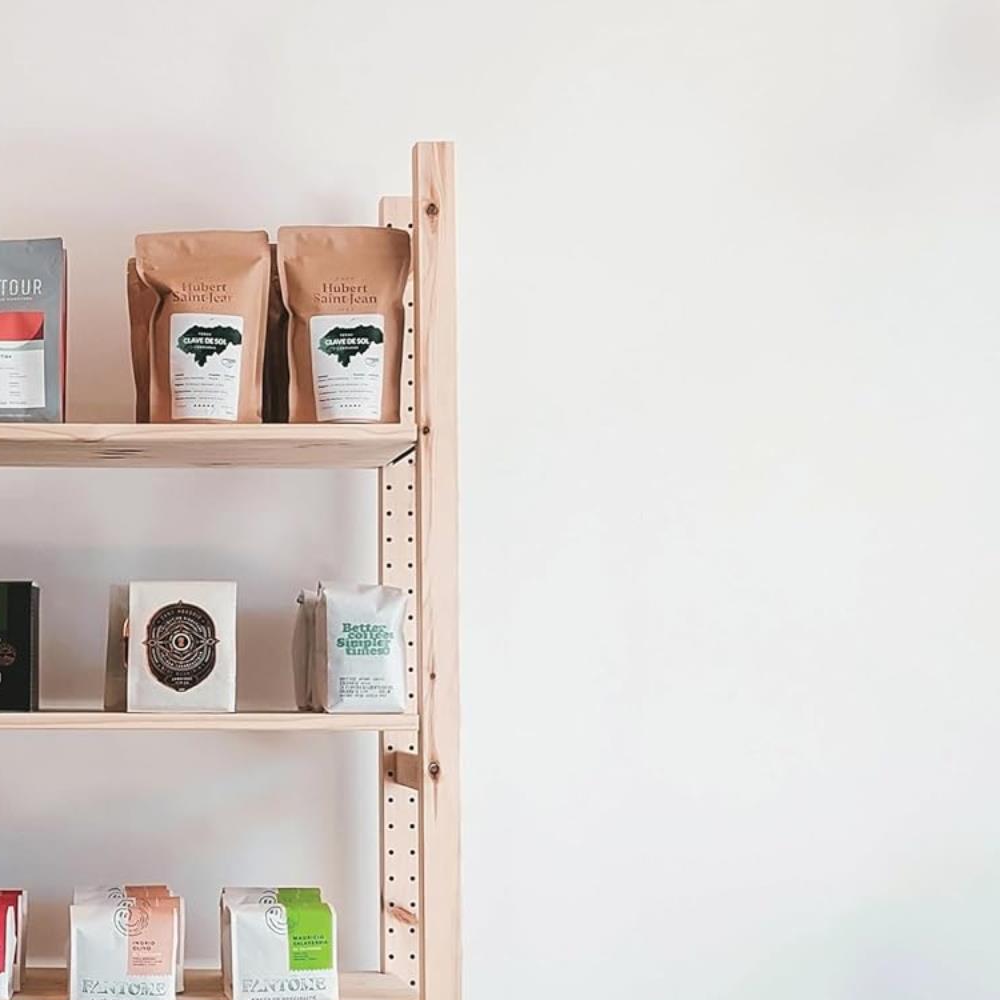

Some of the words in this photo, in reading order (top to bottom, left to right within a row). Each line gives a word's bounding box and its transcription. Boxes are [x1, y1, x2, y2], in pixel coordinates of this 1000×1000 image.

[181, 281, 228, 293] Hubert
[322, 282, 368, 294] Hubert
[183, 336, 204, 345] CLAVE
[204, 337, 214, 345] DE
[215, 337, 228, 346] SOL
[324, 337, 346, 346] CLAVE
[346, 337, 356, 345] DE
[357, 337, 370, 346] SOL
[342, 622, 387, 633] Better
[336, 638, 391, 649] Simpler
